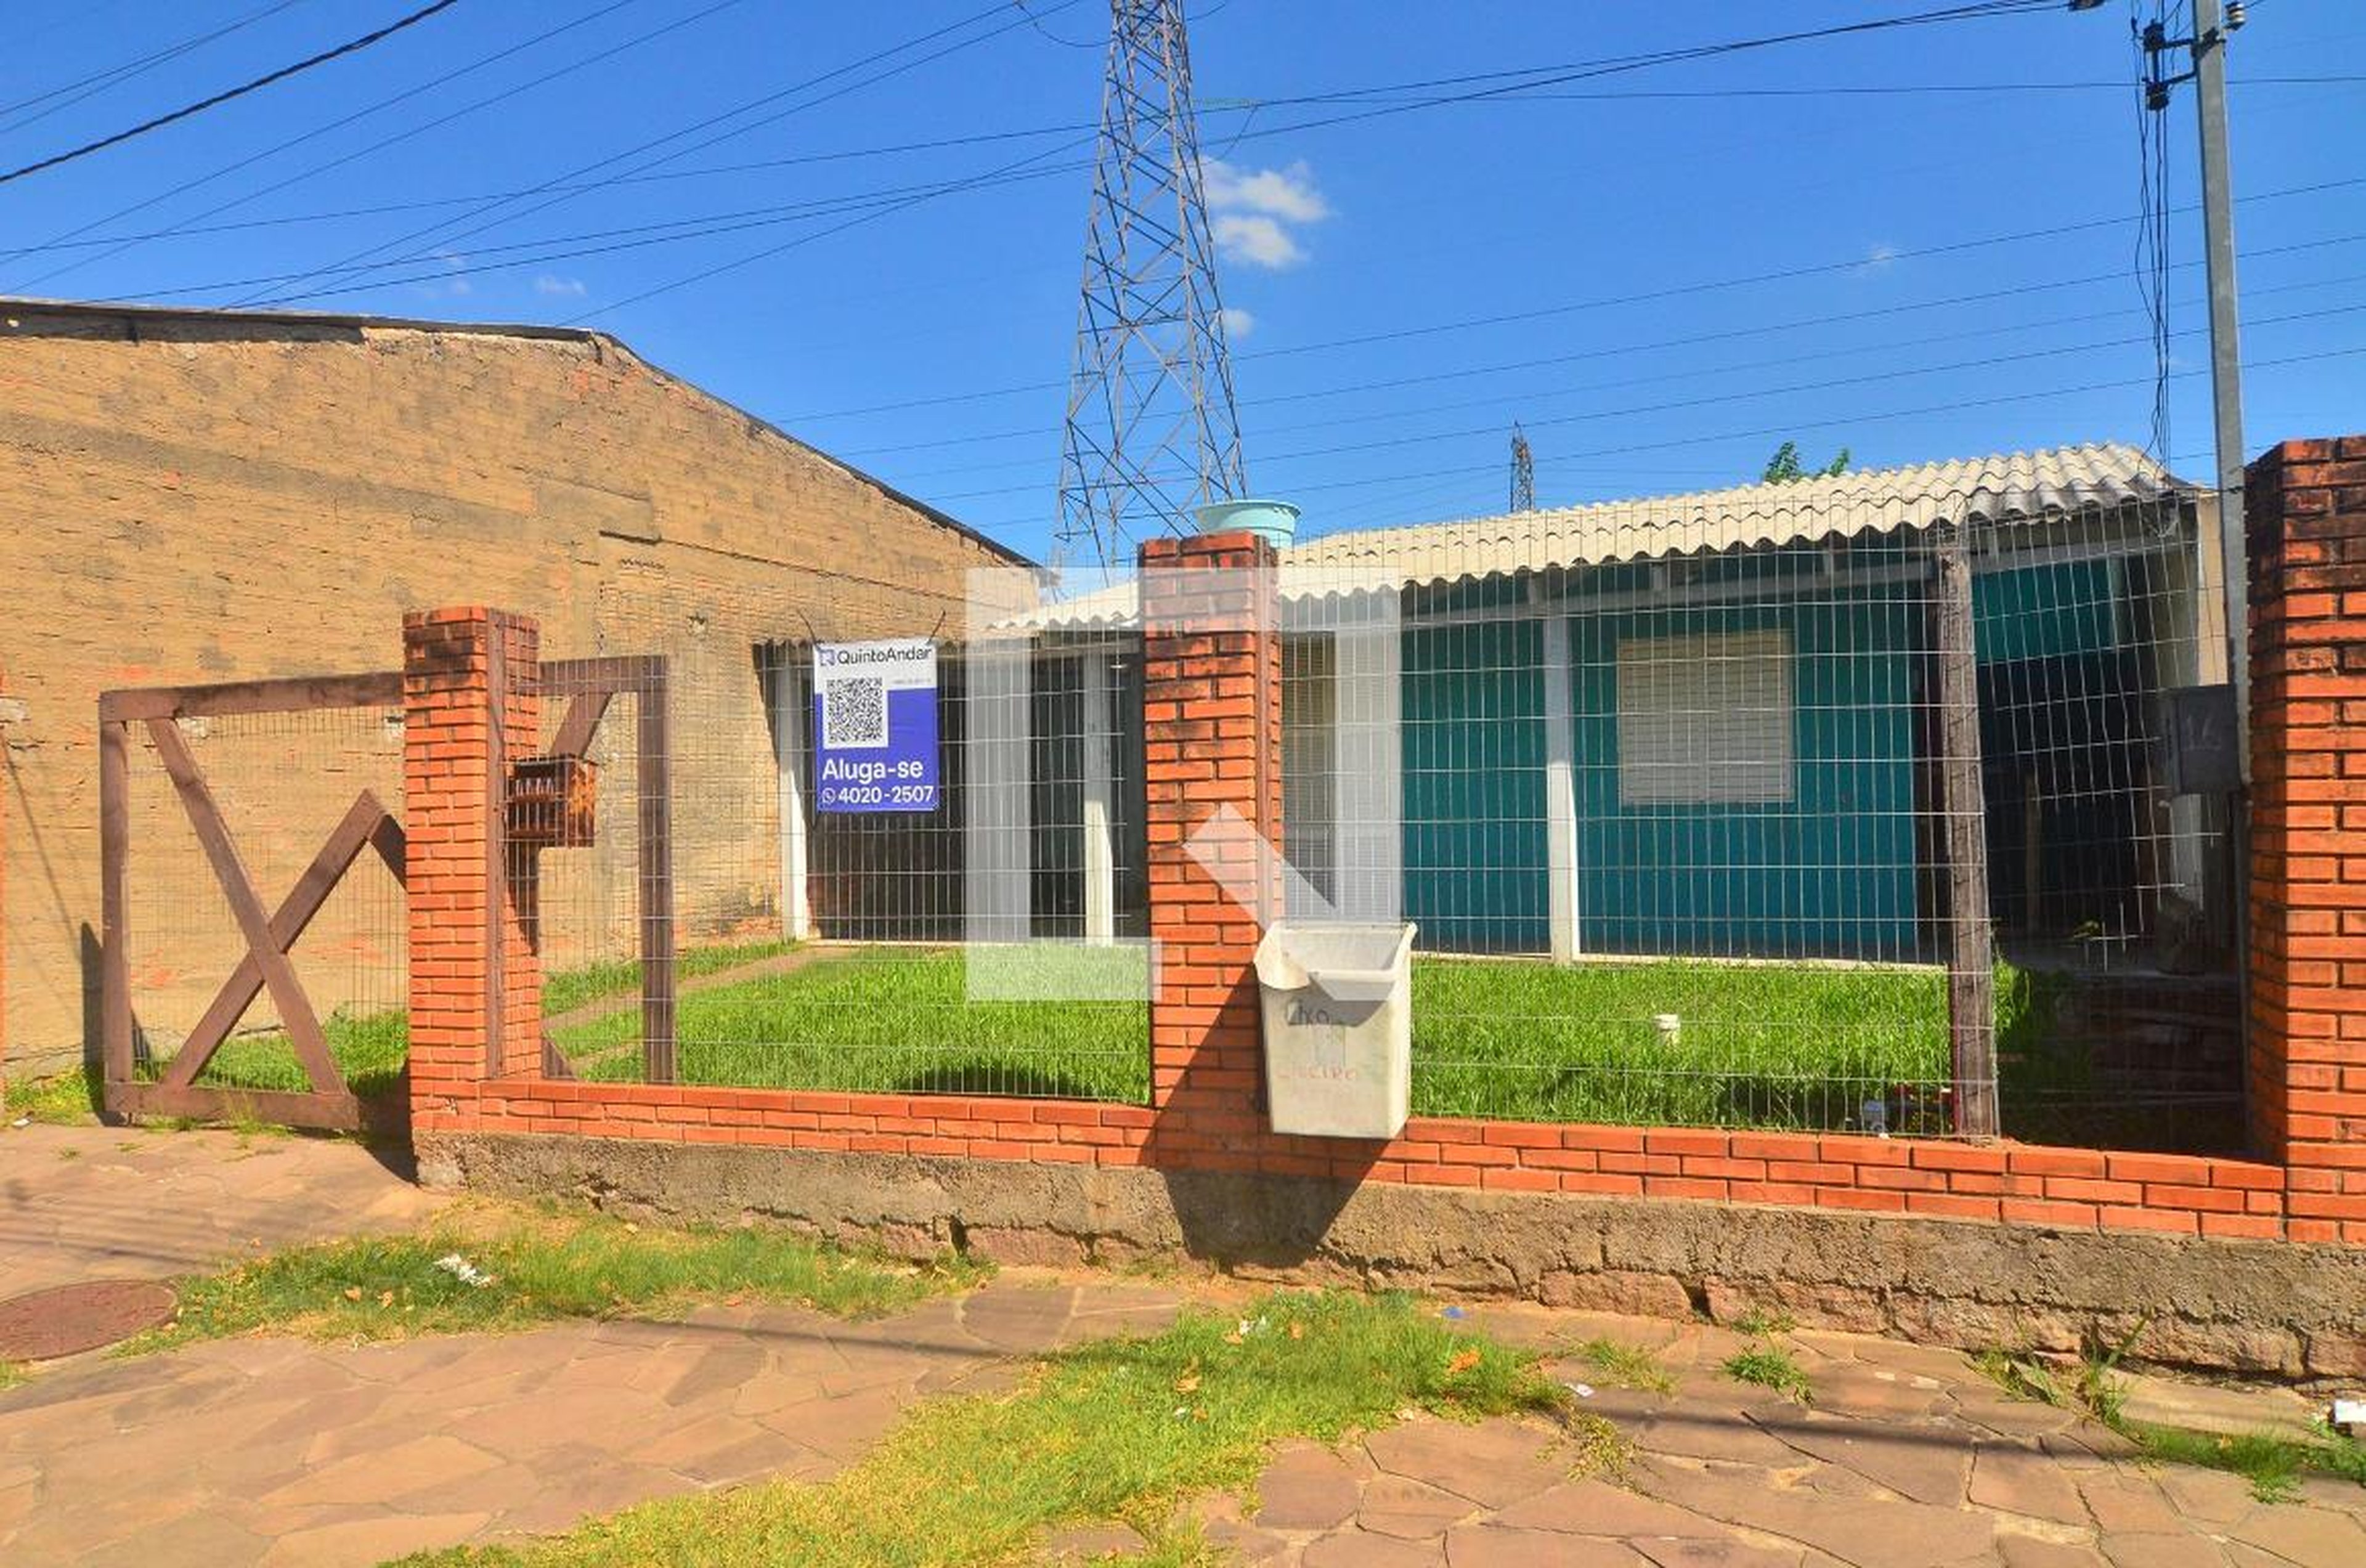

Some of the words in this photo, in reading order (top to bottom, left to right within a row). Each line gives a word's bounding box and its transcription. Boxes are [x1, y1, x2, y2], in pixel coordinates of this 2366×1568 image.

[837, 647, 932, 664] QuintoAndar
[822, 758, 924, 784] Aluga-se
[837, 786, 934, 803] 4020-2507
